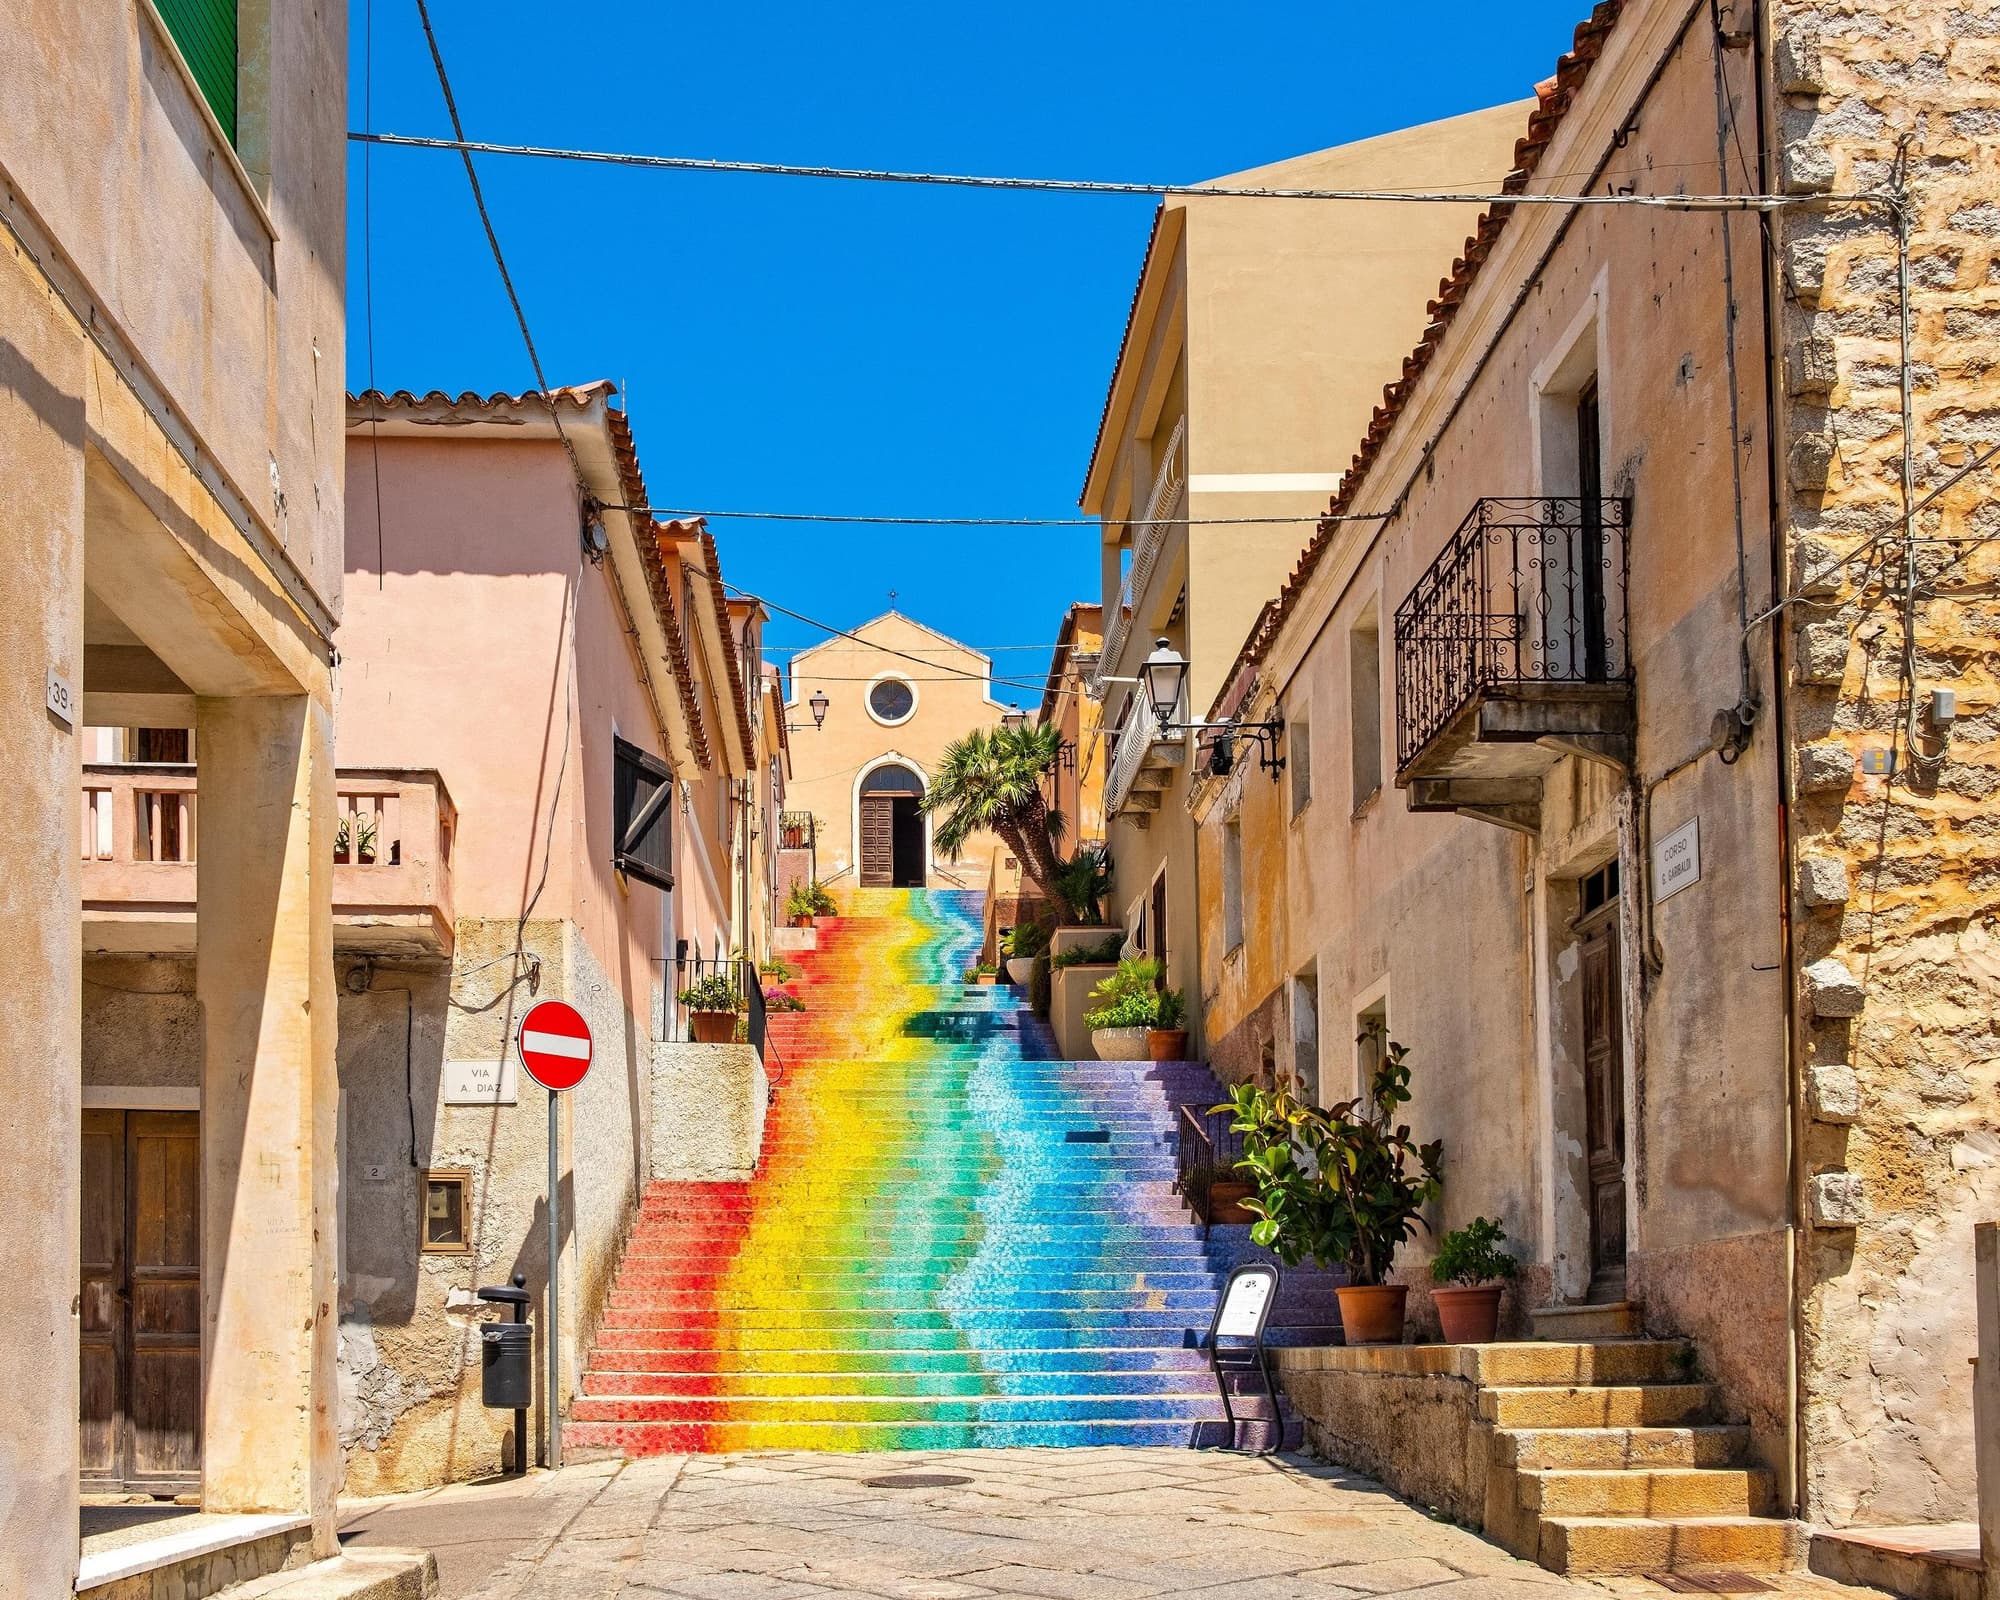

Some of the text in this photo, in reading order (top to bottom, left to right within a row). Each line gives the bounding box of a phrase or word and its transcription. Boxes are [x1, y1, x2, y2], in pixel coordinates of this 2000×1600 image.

[53, 682, 68, 710] 39
[1664, 838, 1688, 862] CORSO
[1668, 858, 1692, 882] GARIBALDI
[471, 1069, 490, 1078] VIA
[460, 1084, 502, 1093] A. DIAZ
[371, 1167, 378, 1177] 2
